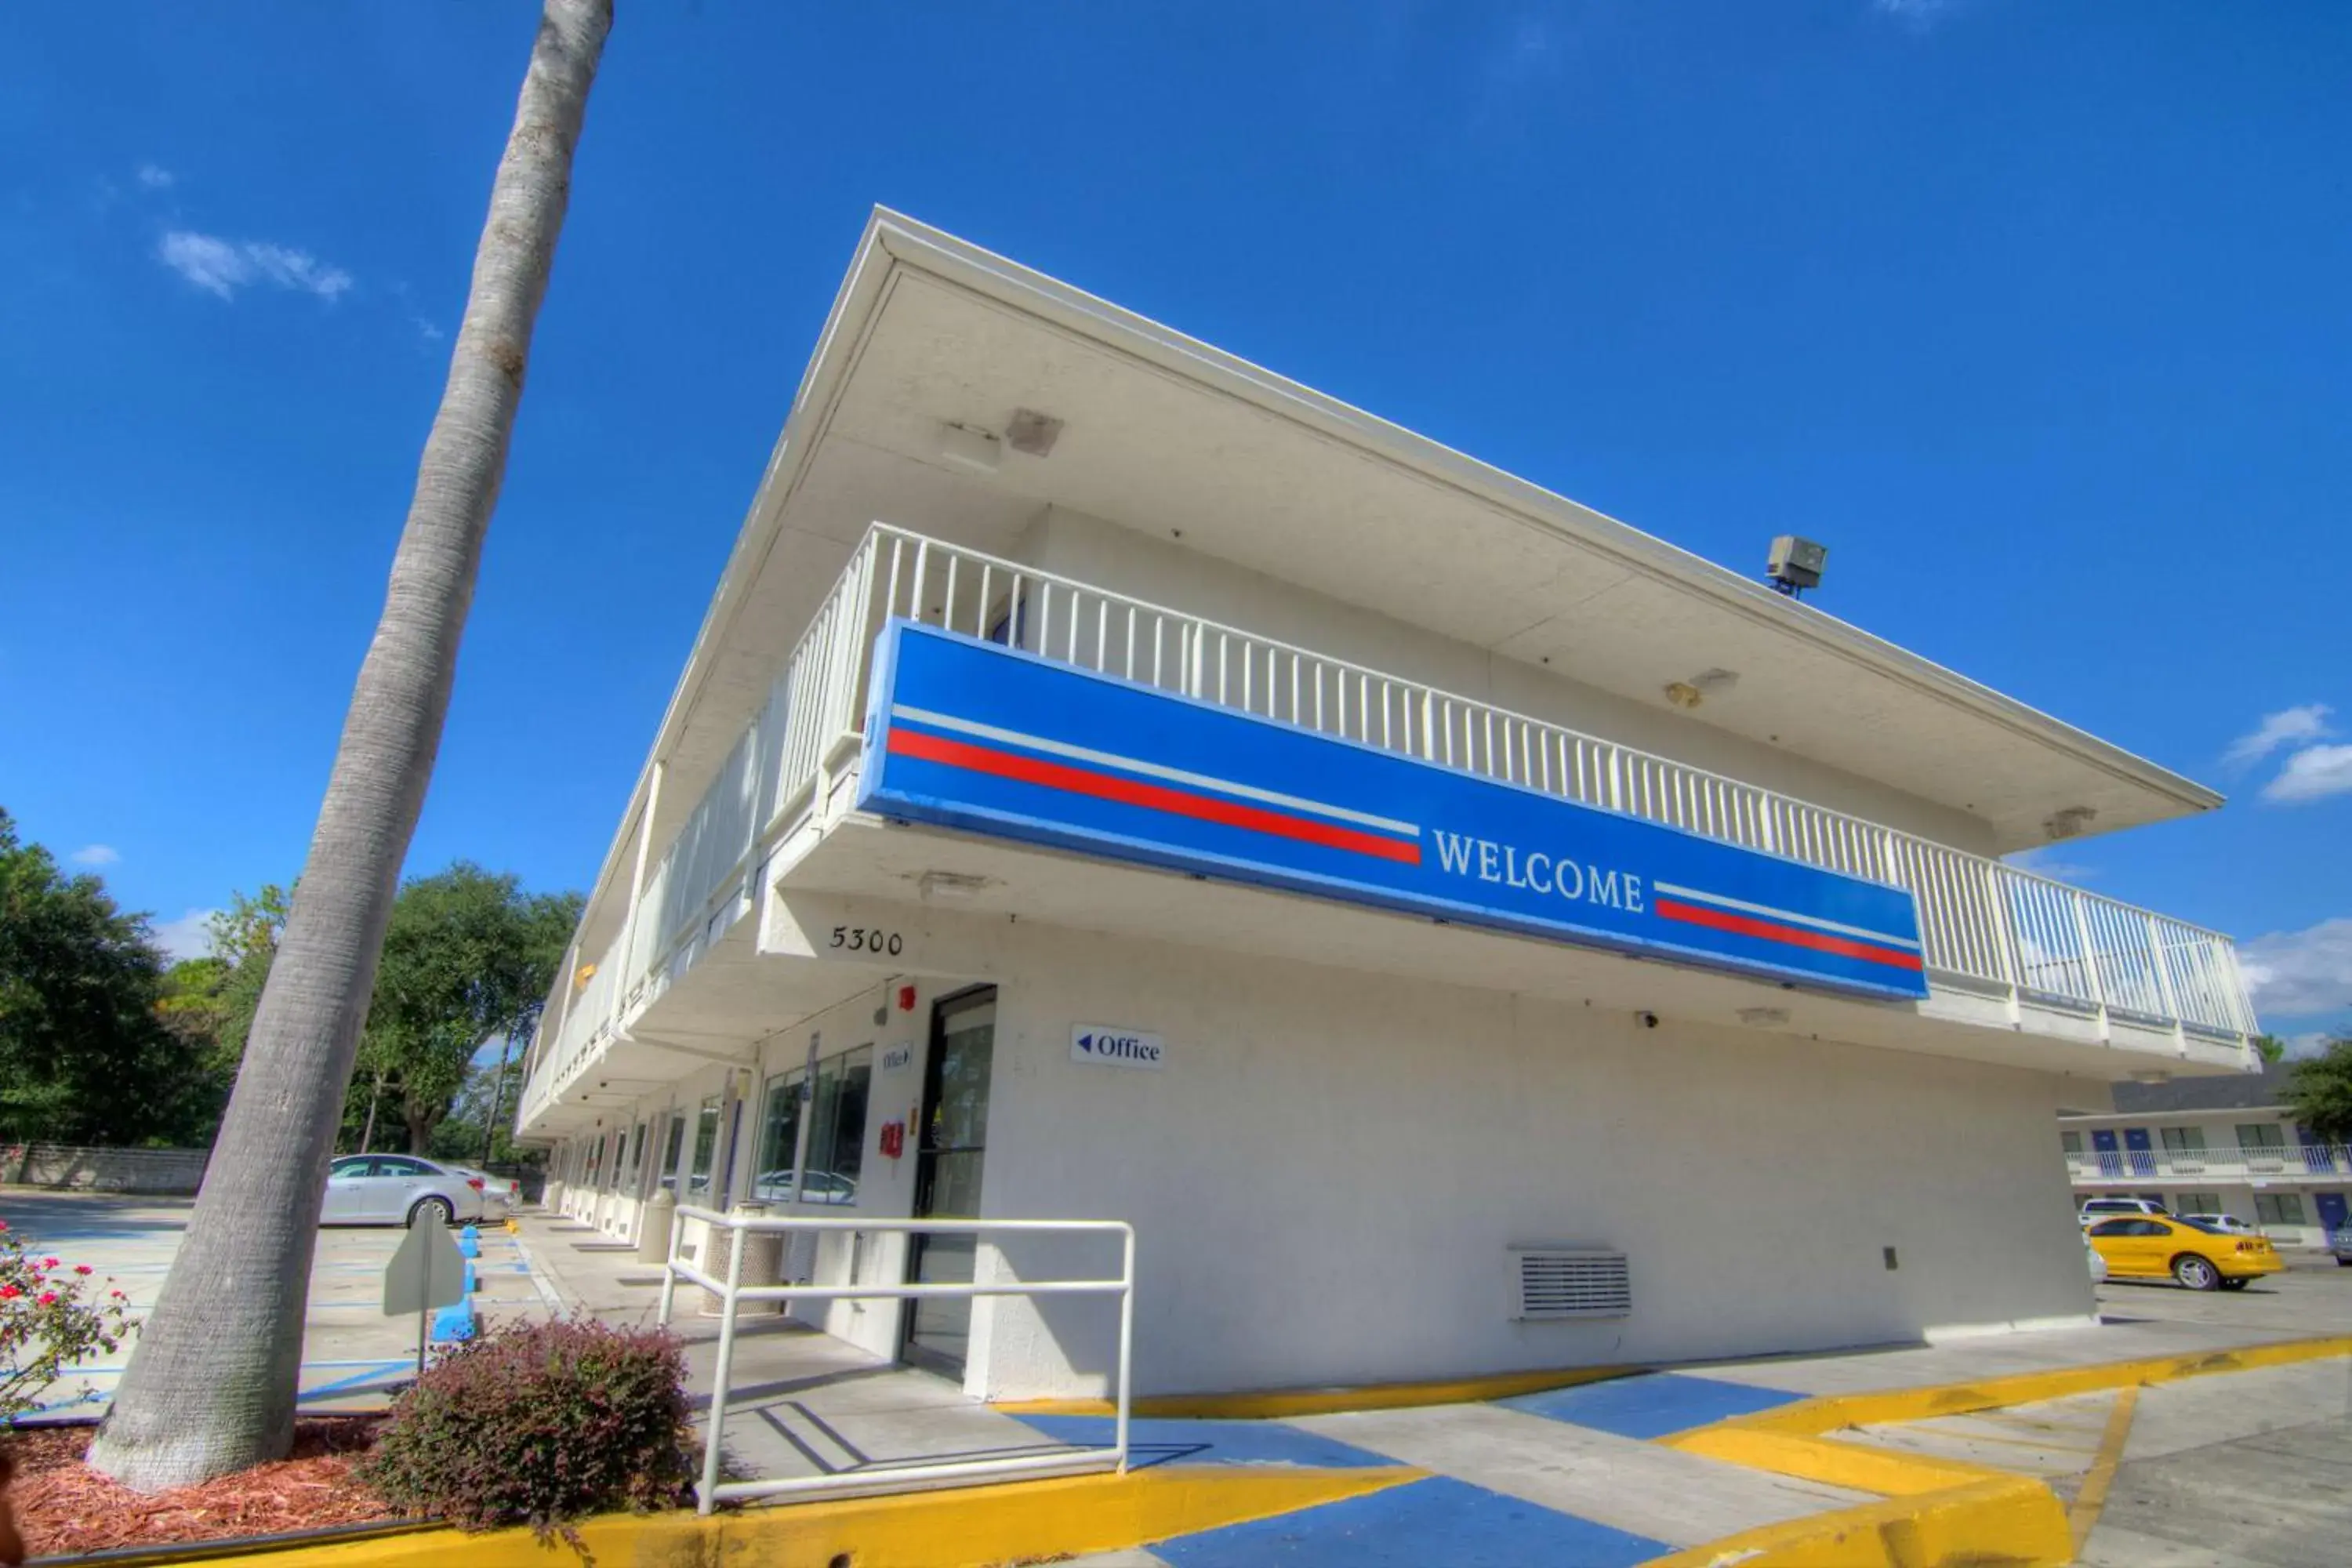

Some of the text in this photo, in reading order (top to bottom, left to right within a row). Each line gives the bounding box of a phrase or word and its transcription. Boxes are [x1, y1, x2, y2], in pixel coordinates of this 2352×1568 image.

[1432, 829, 1644, 913] WELCOME
[829, 926, 902, 956] 5300
[1098, 1035, 1160, 1061] Office
